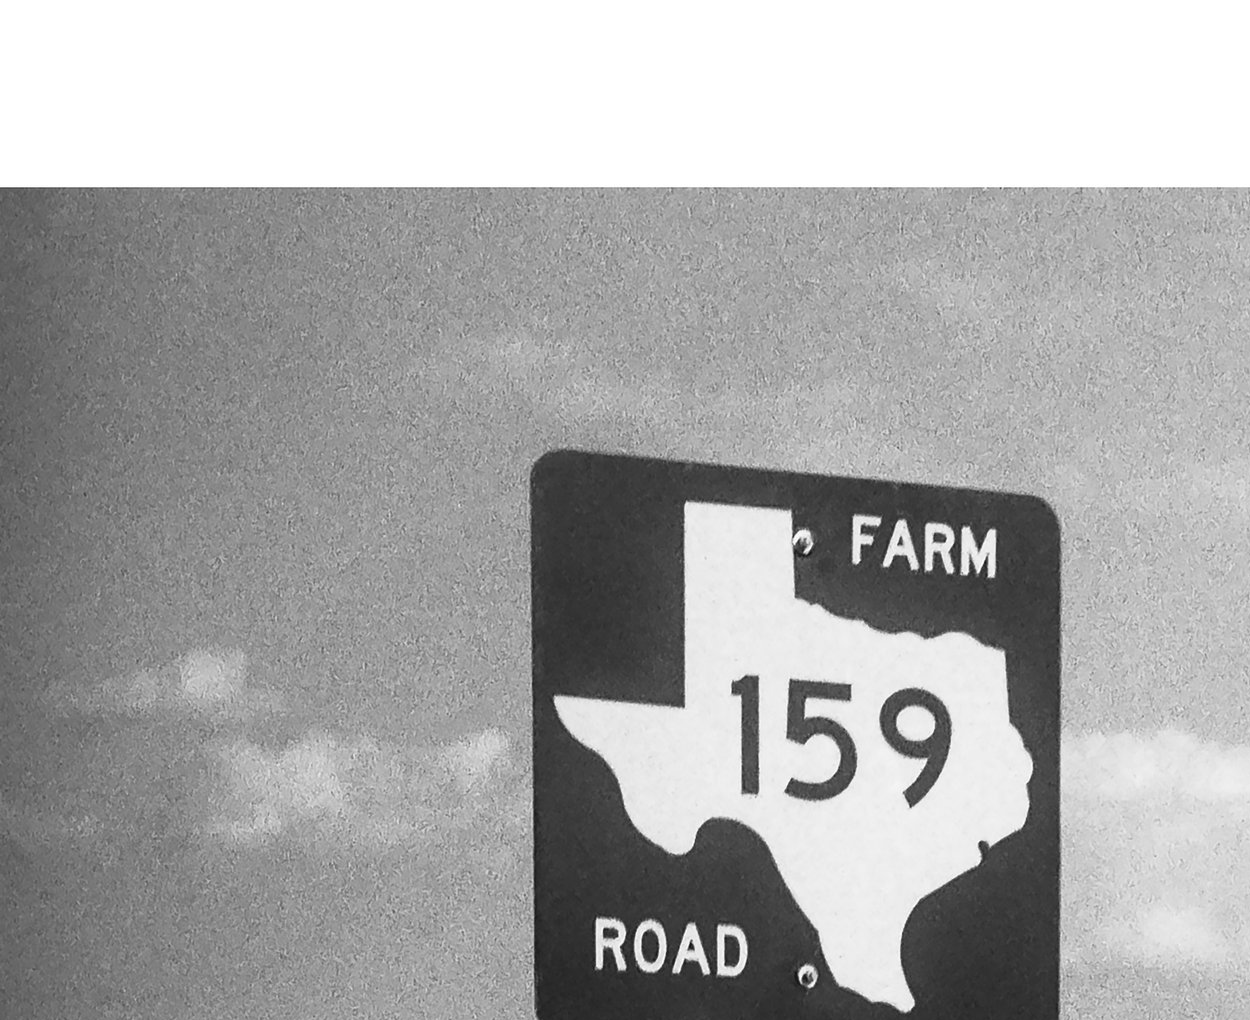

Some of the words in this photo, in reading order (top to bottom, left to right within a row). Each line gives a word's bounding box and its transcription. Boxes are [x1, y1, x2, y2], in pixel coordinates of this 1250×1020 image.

[851, 513, 998, 579] FARM
[731, 674, 953, 809] 159
[594, 917, 749, 977] ROAD
